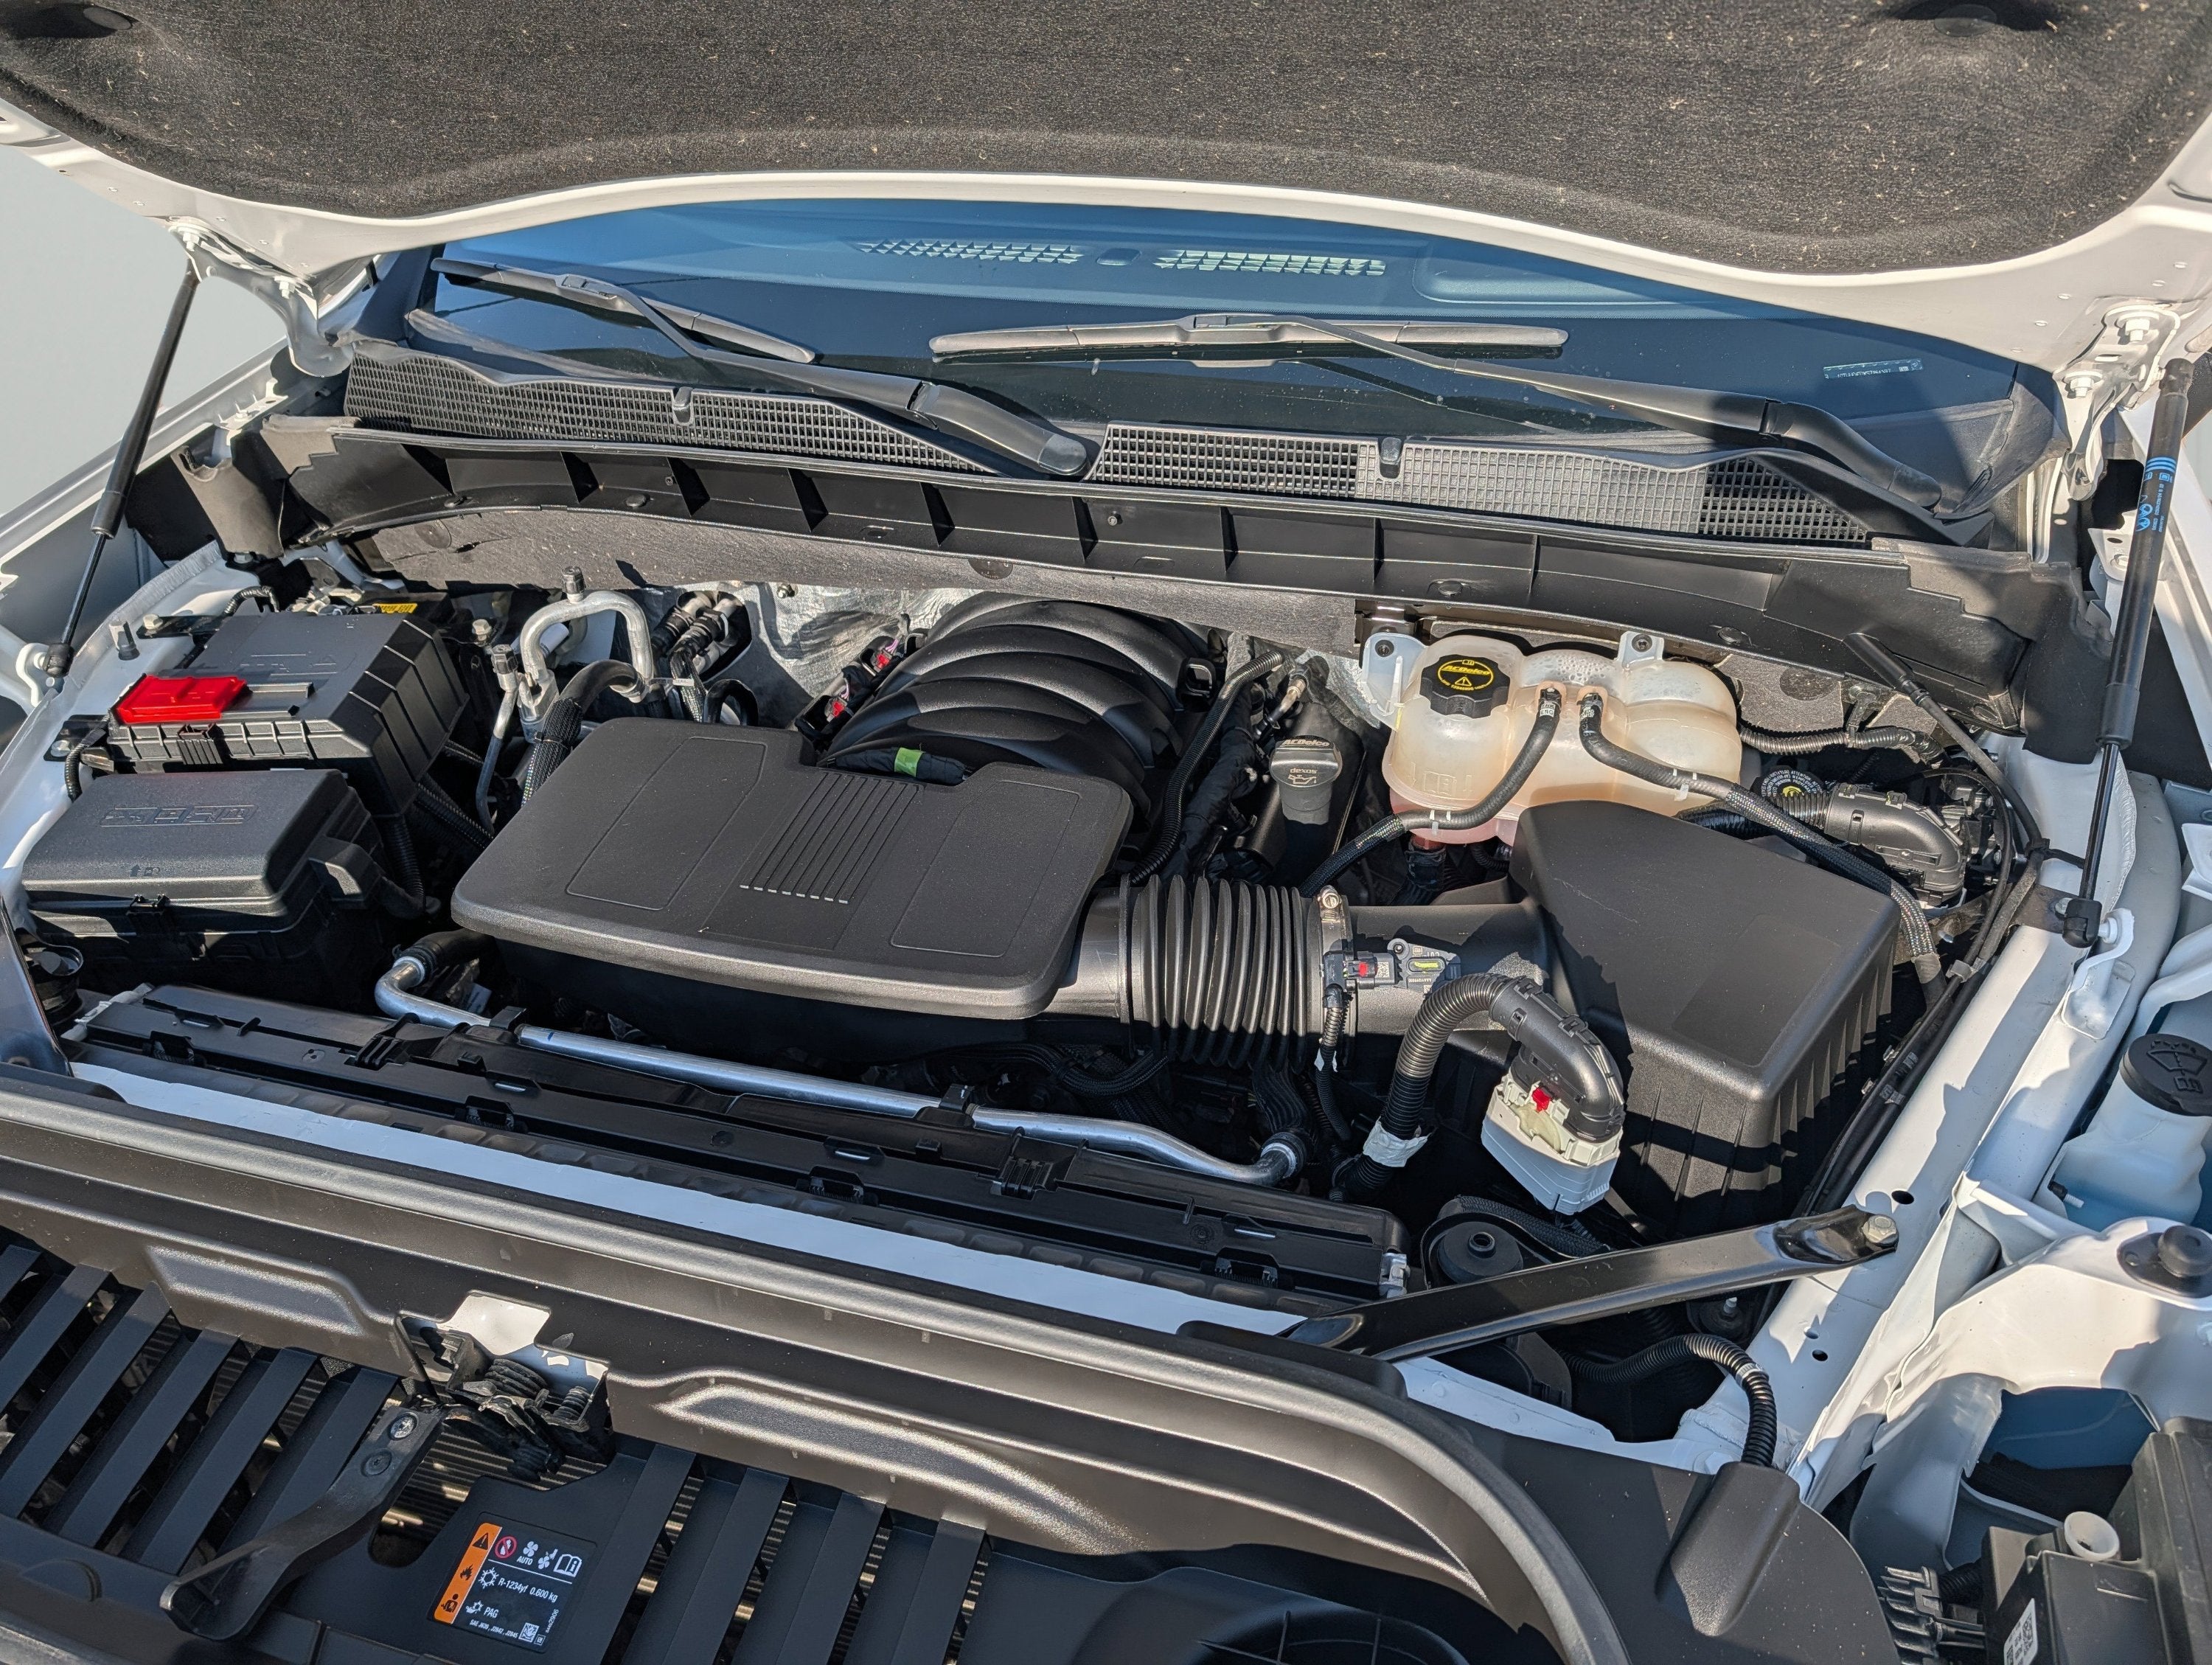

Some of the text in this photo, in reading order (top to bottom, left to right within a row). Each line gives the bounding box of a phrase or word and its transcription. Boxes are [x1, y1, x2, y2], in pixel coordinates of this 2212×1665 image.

[516, 1556, 533, 1565] AUTO
[498, 1578, 558, 1603] R-1234yf 0.600 kg
[484, 1607, 499, 1619] PAG
